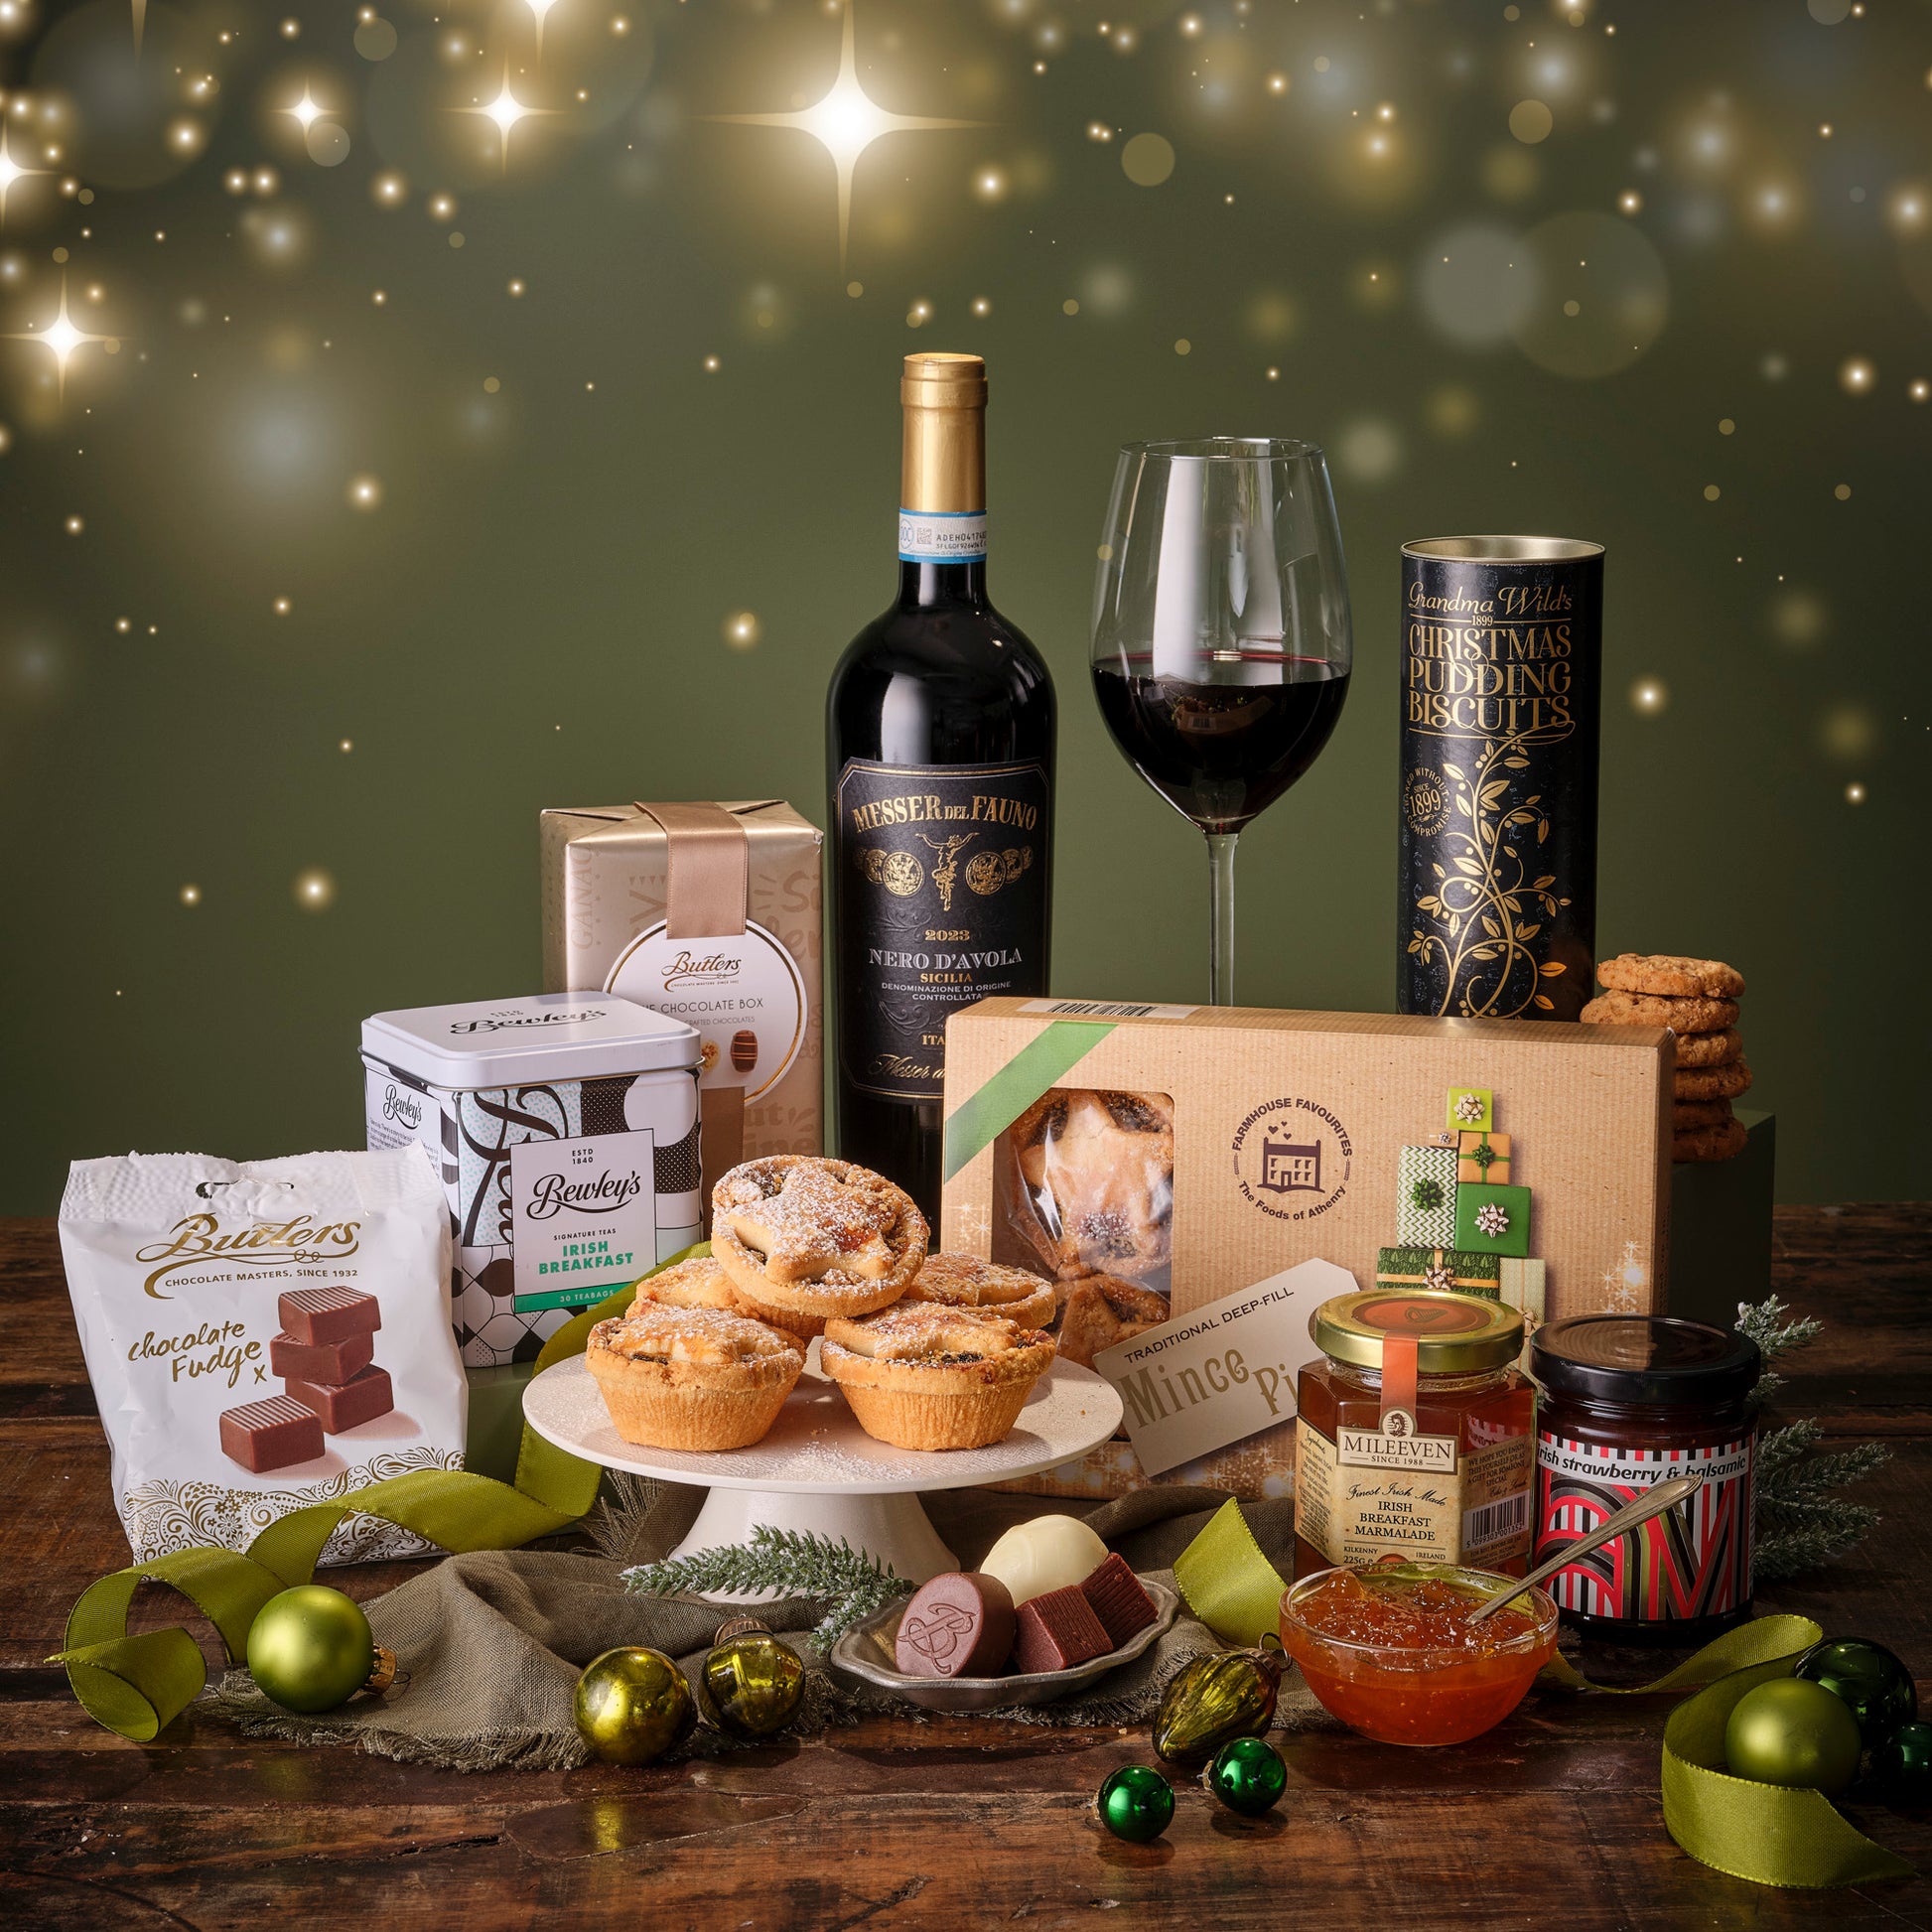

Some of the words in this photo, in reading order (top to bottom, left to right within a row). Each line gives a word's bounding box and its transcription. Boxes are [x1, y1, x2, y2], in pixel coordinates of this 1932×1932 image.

[1408, 581, 1494, 613] Grandma
[1497, 585, 1573, 616] Wild's
[1471, 615, 1493, 626] 1899
[1410, 624, 1572, 661] CHRISTMAS
[1409, 656, 1572, 696] PUDDING
[1409, 694, 1572, 731] BISCUITS
[1414, 782, 1430, 793] SINCE
[1415, 767, 1449, 796] WITHOUT
[852, 795, 944, 834] MESSER
[944, 805, 970, 820] DEL
[970, 795, 1038, 832] FAUNO
[1410, 789, 1442, 817] 1899
[1408, 805, 1451, 837] COMPROMISE
[924, 928, 970, 941] 2023
[661, 951, 742, 978] Butlers
[869, 948, 929, 970] NERO
[933, 947, 1023, 970] D'AVOLA
[882, 981, 961, 993] DENOMINAZIONE
[975, 980, 1012, 992] ORIGINE
[919, 972, 973, 983] SICILIA
[660, 999, 735, 1014] CHOCOLATE
[739, 998, 763, 1009] BOX
[912, 993, 983, 1002] CONTROLLATA
[450, 1010, 607, 1035] Bewley's
[713, 1016, 756, 1025] CHOCOLATES
[383, 1084, 422, 1130] Bewley's
[1231, 1097, 1292, 1153] FARMHOUSE
[1296, 1097, 1352, 1158] FAVOURITES
[526, 1169, 641, 1220] Bewley's
[1238, 1180, 1257, 1202] The
[1255, 1196, 1290, 1221] Foods
[1293, 1208, 1306, 1221] of
[1308, 1184, 1347, 1216] Athenry
[135, 1211, 362, 1264] Butlers
[553, 1230, 596, 1241] SIGNATURE
[599, 1228, 617, 1237] TEAS
[563, 1241, 609, 1257] IRISH
[538, 1252, 634, 1275] BREAKFAST
[165, 1275, 233, 1288] CHOCOLATE
[236, 1271, 293, 1283] MASTERS,
[296, 1269, 329, 1279] SINCE
[332, 1269, 358, 1279] 1932
[559, 1294, 572, 1303] 30
[574, 1290, 615, 1302] TEABAGS
[1125, 1319, 1220, 1364] TRADITIONAL
[1221, 1286, 1295, 1323] DEEP-FILL
[128, 1320, 245, 1362] chocolate
[172, 1339, 263, 1389] Fudge
[1117, 1348, 1251, 1429] Mince
[1344, 1436, 1451, 1458] MILEEVEN
[1371, 1455, 1400, 1464] SINCE
[1562, 1456, 1663, 1484] strawberry
[1667, 1467, 1680, 1479] &
[1686, 1455, 1746, 1476] balsamic
[1346, 1483, 1382, 1500] Finest
[1382, 1482, 1414, 1496] Irish
[1415, 1489, 1448, 1506] Made
[1378, 1501, 1413, 1512] IRISH
[1360, 1513, 1431, 1527] BREAKFAST
[1354, 1525, 1436, 1541] MARMALADE
[1466, 1539, 1471, 1549] 5
